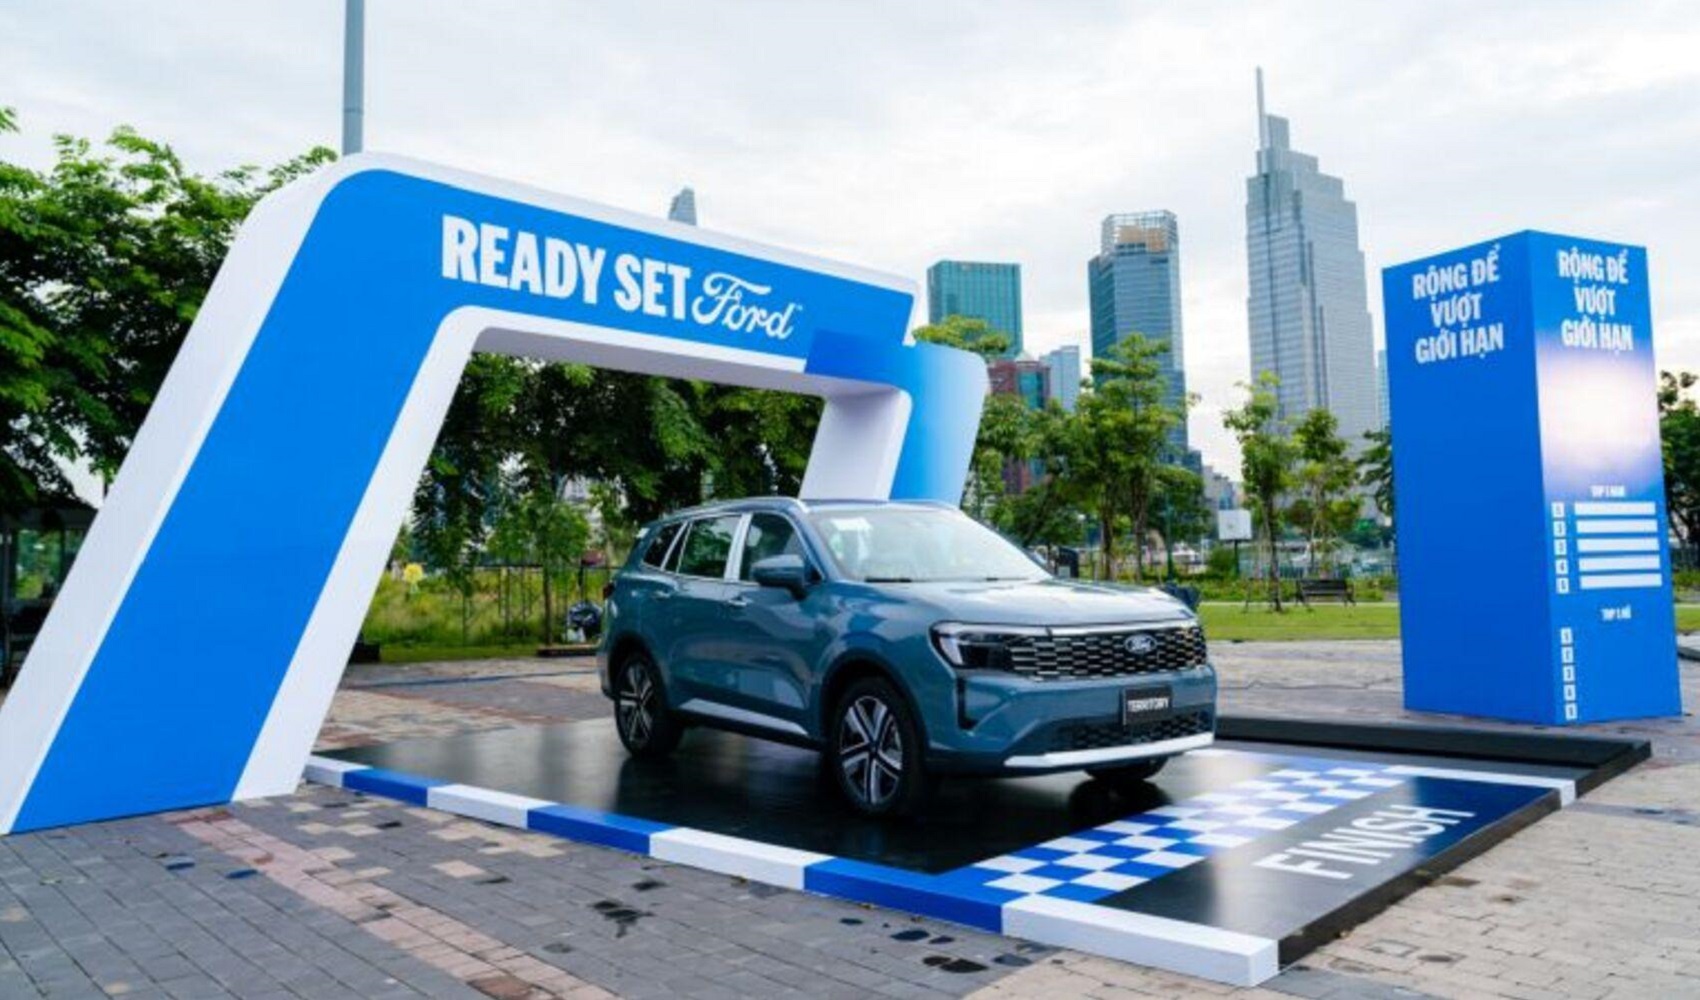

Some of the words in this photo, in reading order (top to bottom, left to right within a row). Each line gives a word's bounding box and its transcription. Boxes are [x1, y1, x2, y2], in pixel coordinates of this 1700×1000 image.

[442, 214, 606, 305] READY
[614, 253, 691, 321] SET
[692, 272, 795, 339] Ford
[1413, 264, 1468, 301] RỘNG
[1557, 246, 1604, 284] RỘNG
[1430, 292, 1482, 328] VƯỢT
[1573, 284, 1616, 321] VƯỢT
[1415, 327, 1457, 364] GIỚI
[1461, 322, 1503, 359] HẠN
[1561, 314, 1597, 348] GIỚI
[1599, 322, 1634, 356] HẠN
[1252, 804, 1476, 880] FINISH
